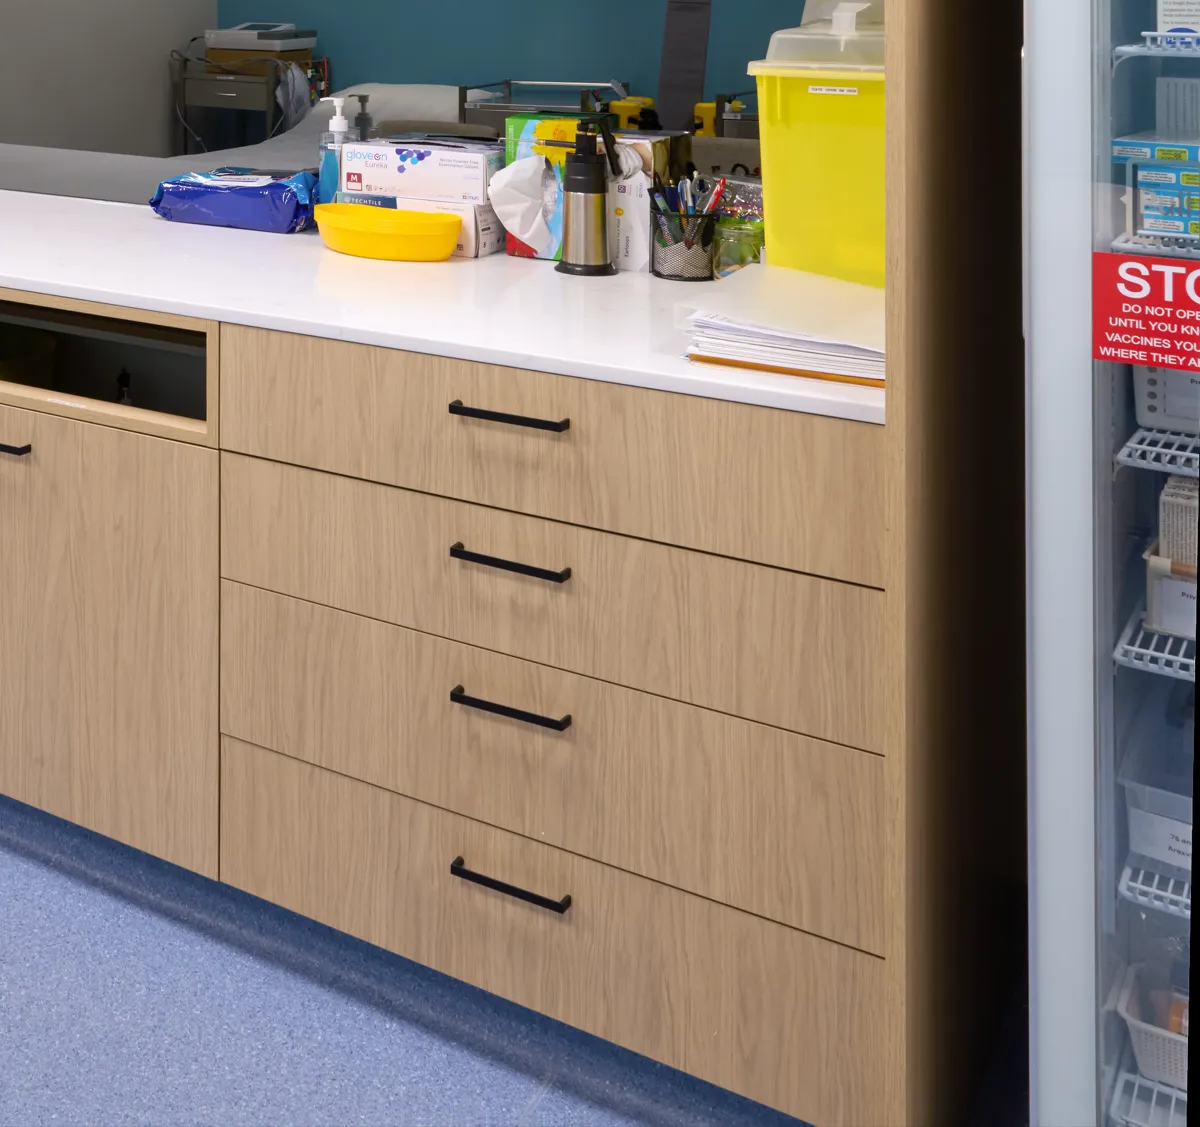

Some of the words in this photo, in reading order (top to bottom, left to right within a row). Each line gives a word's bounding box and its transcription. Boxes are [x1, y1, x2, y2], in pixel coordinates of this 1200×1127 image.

[365, 161, 388, 169] Eureka
[352, 198, 382, 206] TECHTILE
[1122, 303, 1142, 314] DO
[1145, 306, 1173, 318] NOT
[1109, 317, 1146, 330] UNTIL
[1149, 321, 1177, 333] YOU
[1105, 332, 1171, 349] VACCINES
[1099, 346, 1147, 361] WHERE
[1151, 353, 1186, 365] THEY
